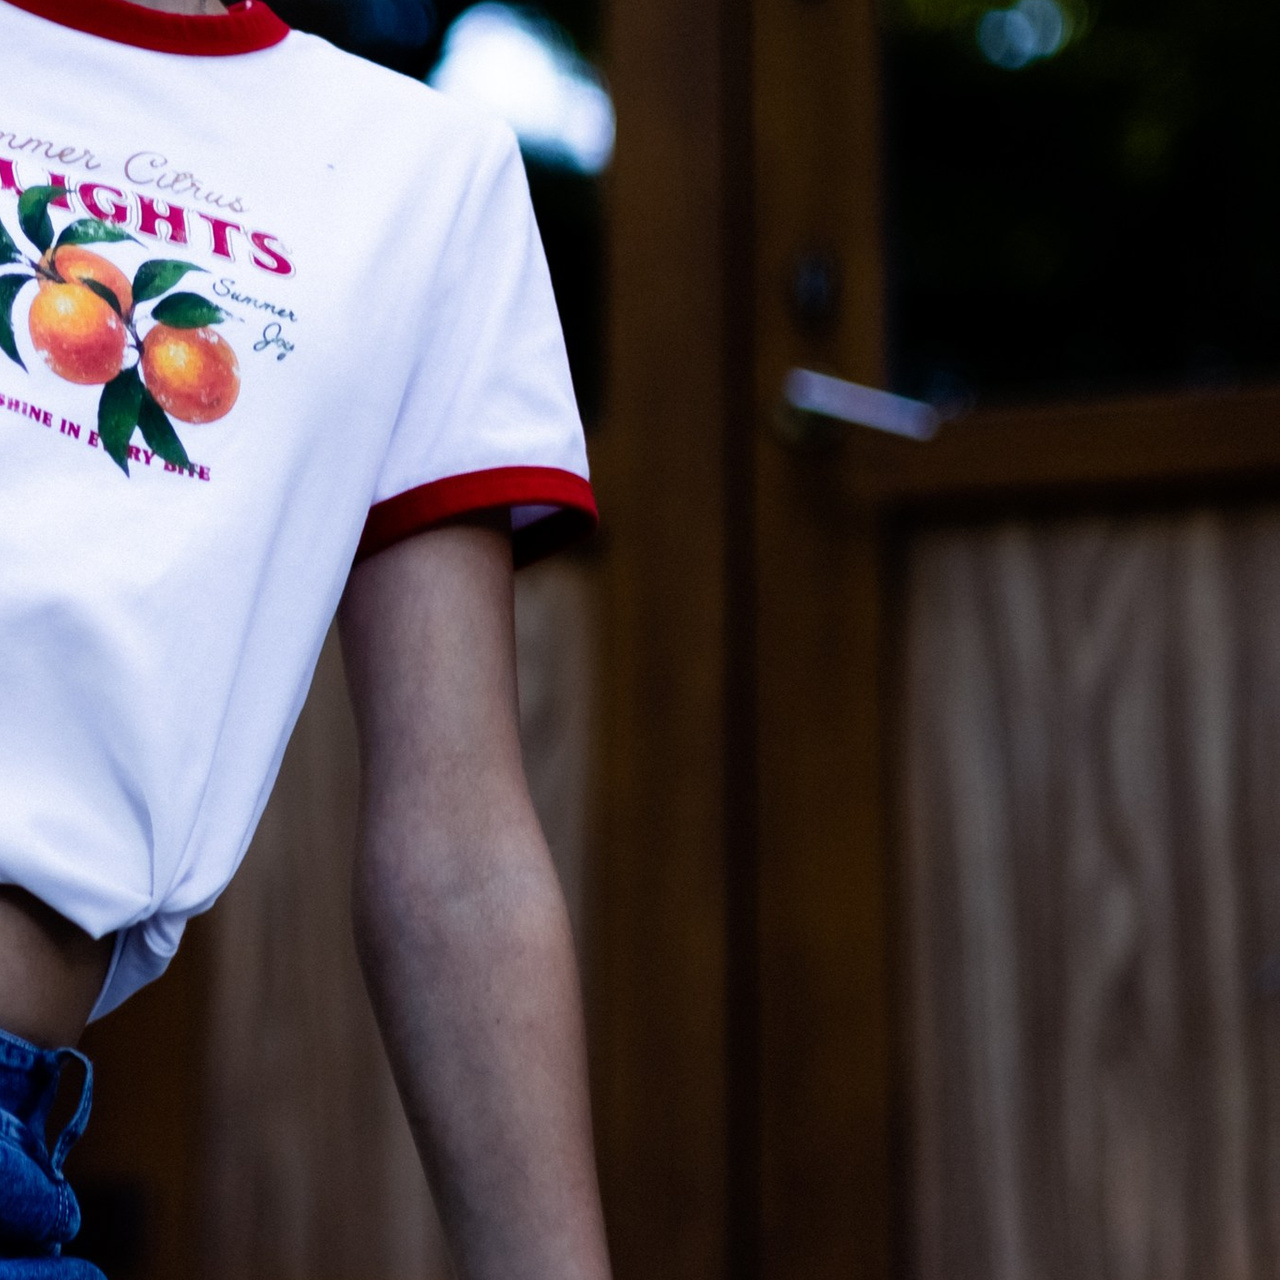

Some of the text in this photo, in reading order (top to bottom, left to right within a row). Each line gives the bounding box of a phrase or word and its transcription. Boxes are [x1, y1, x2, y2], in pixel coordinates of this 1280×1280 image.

[124, 151, 249, 213] Citrus
[213, 278, 297, 322] Summer
[253, 322, 295, 361] Joy
[59, 418, 81, 440] IN
[87, 430, 156, 466] ERY
